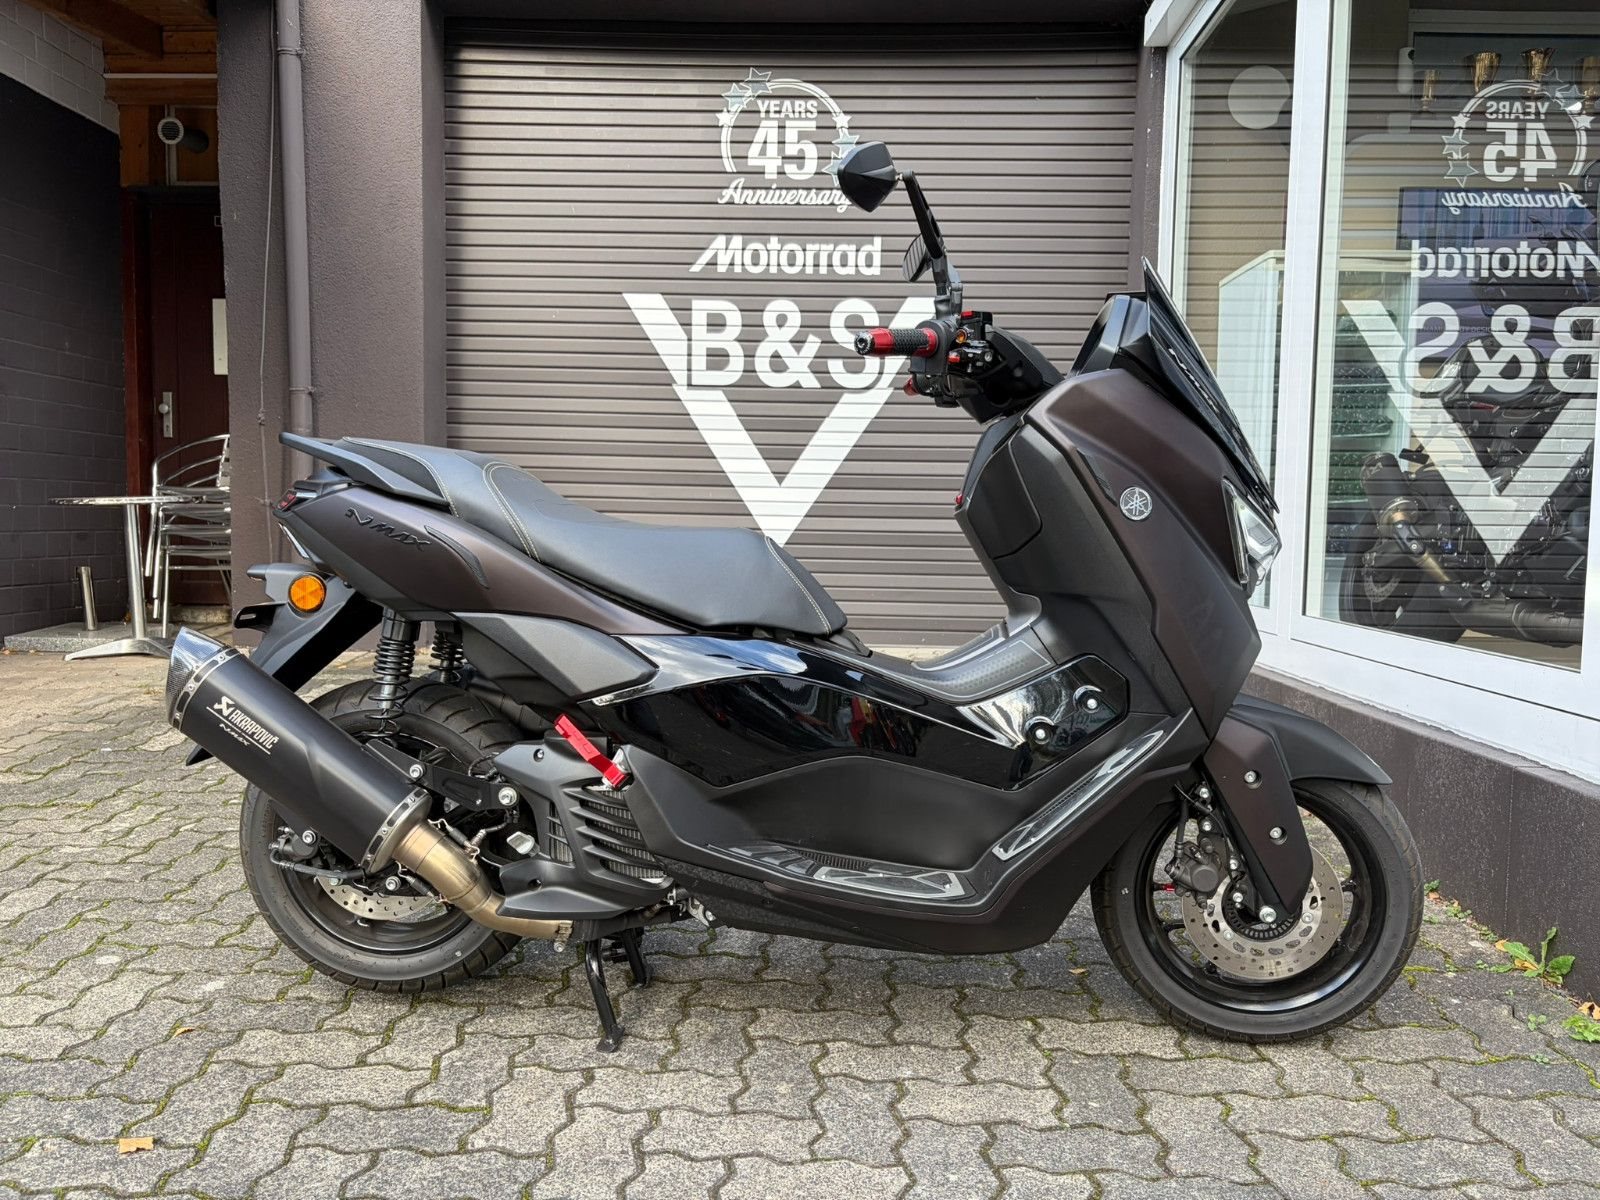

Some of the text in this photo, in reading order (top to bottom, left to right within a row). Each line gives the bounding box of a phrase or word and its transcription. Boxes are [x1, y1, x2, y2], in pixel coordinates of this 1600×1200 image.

[757, 99, 818, 119] YEARS
[747, 120, 818, 180] 45
[717, 177, 852, 213] Anniversary
[689, 234, 882, 276] Motorrad
[345, 507, 432, 552] NMAX
